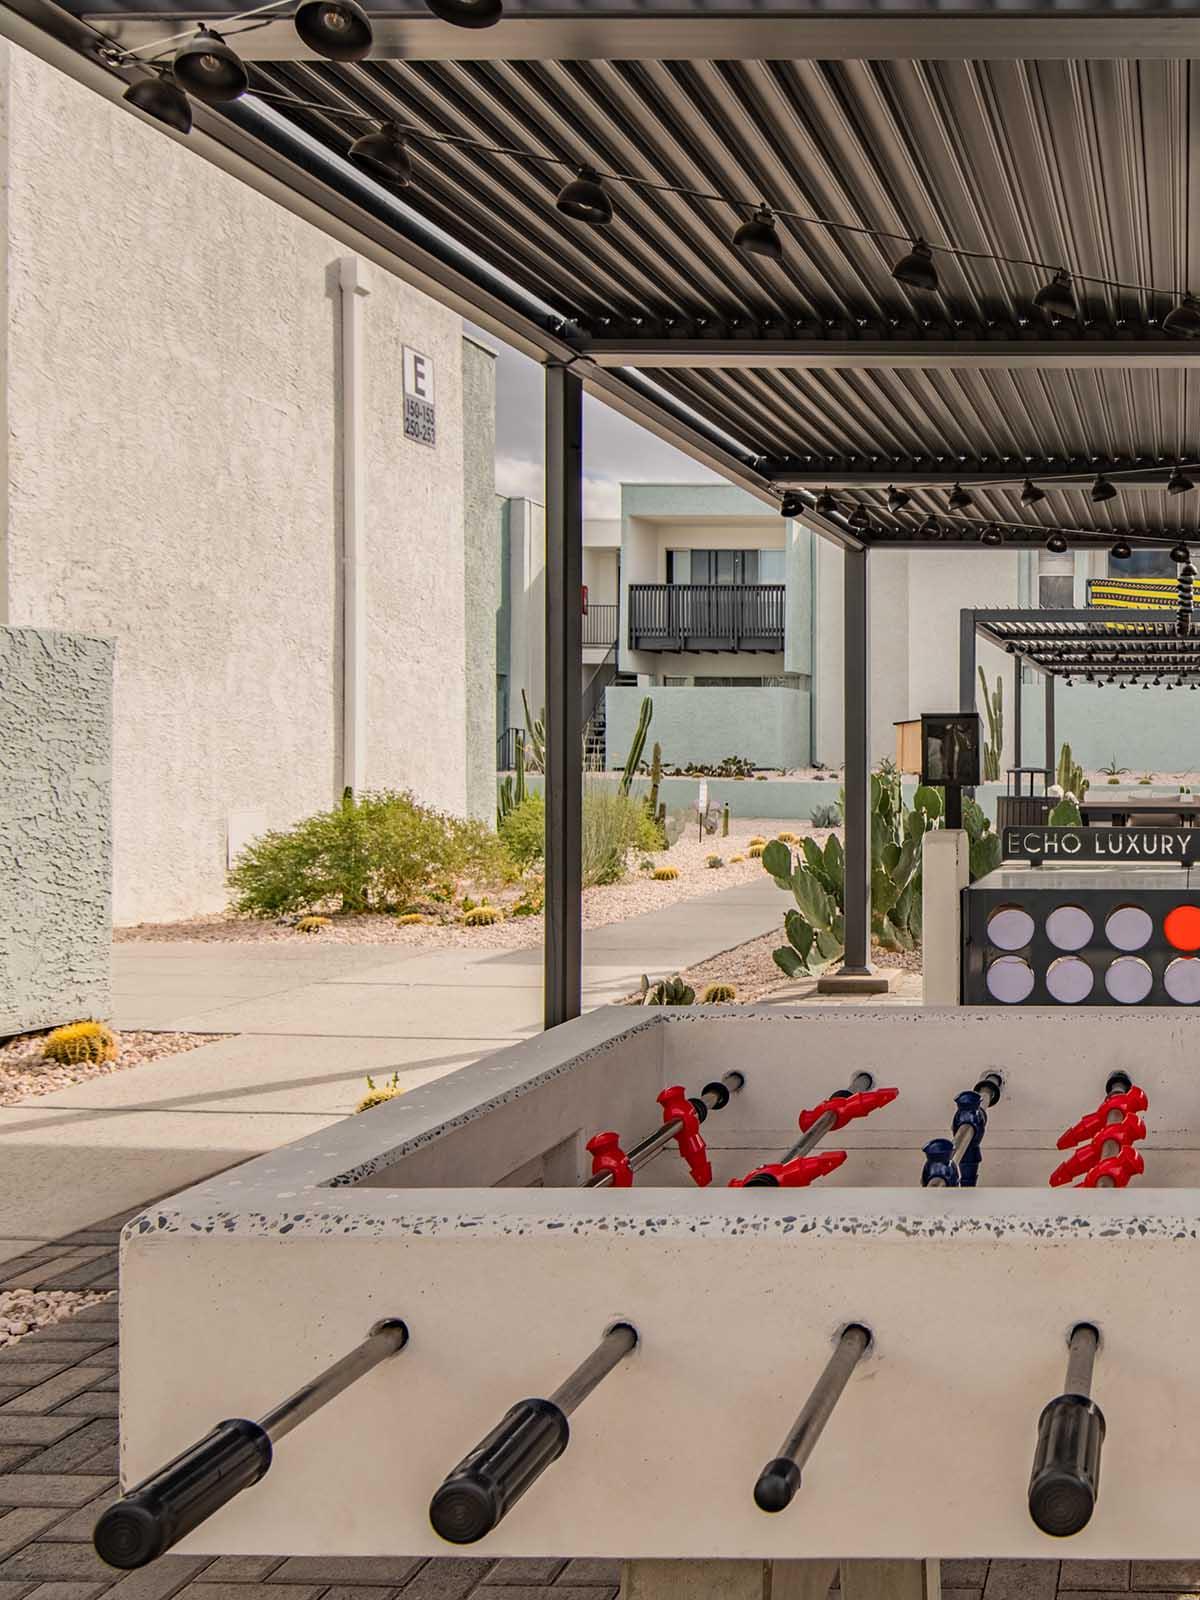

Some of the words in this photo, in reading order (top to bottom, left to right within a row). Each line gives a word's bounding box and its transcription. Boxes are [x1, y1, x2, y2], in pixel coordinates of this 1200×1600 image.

[414, 355, 425, 396] E
[406, 398, 434, 425] 150-153
[406, 417, 435, 444] 250-253
[1008, 832, 1081, 853] ECHO
[1095, 833, 1192, 855] LUXURY
